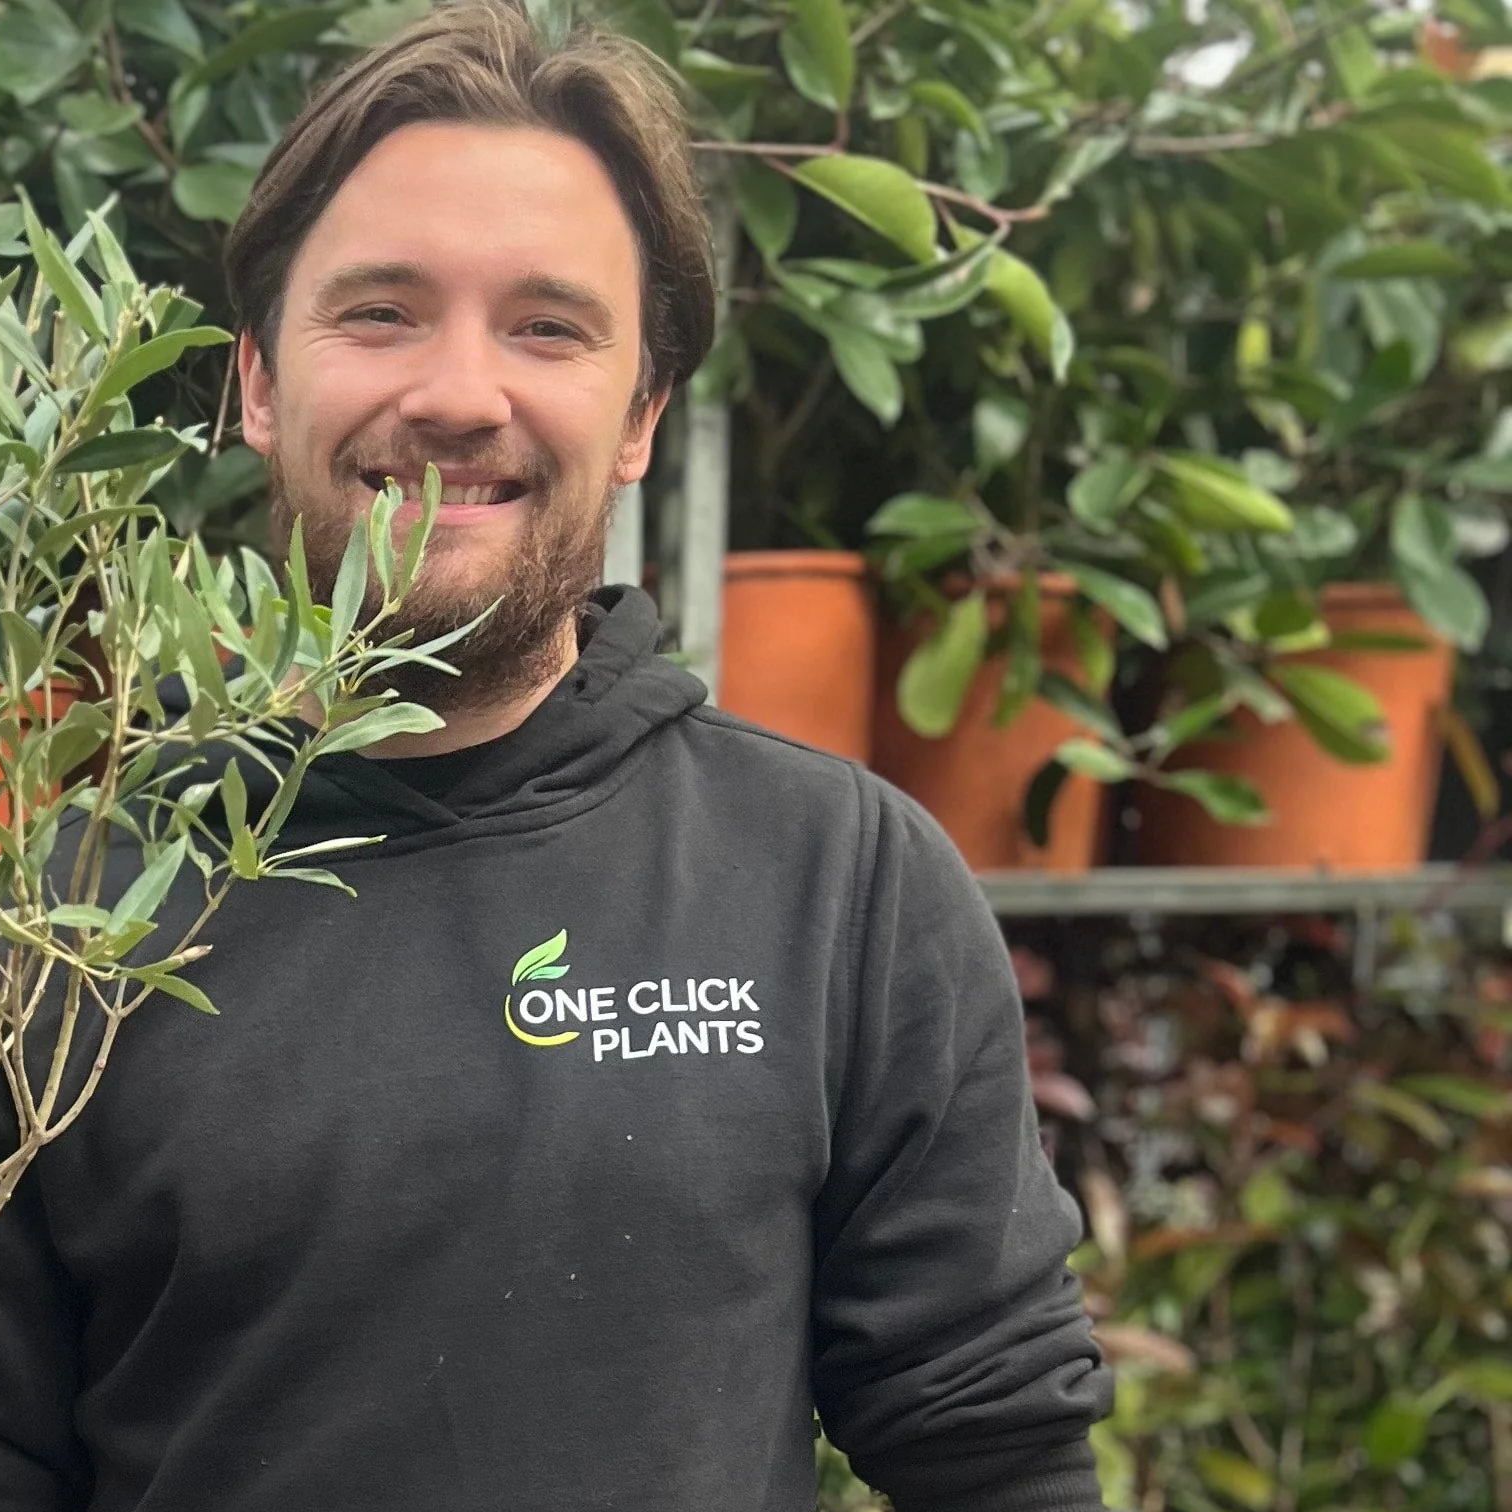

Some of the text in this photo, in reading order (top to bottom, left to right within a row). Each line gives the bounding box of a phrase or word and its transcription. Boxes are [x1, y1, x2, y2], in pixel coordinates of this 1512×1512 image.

[519, 977, 760, 1024] ONE CLICK
[592, 1020, 765, 1062] PLANTS
